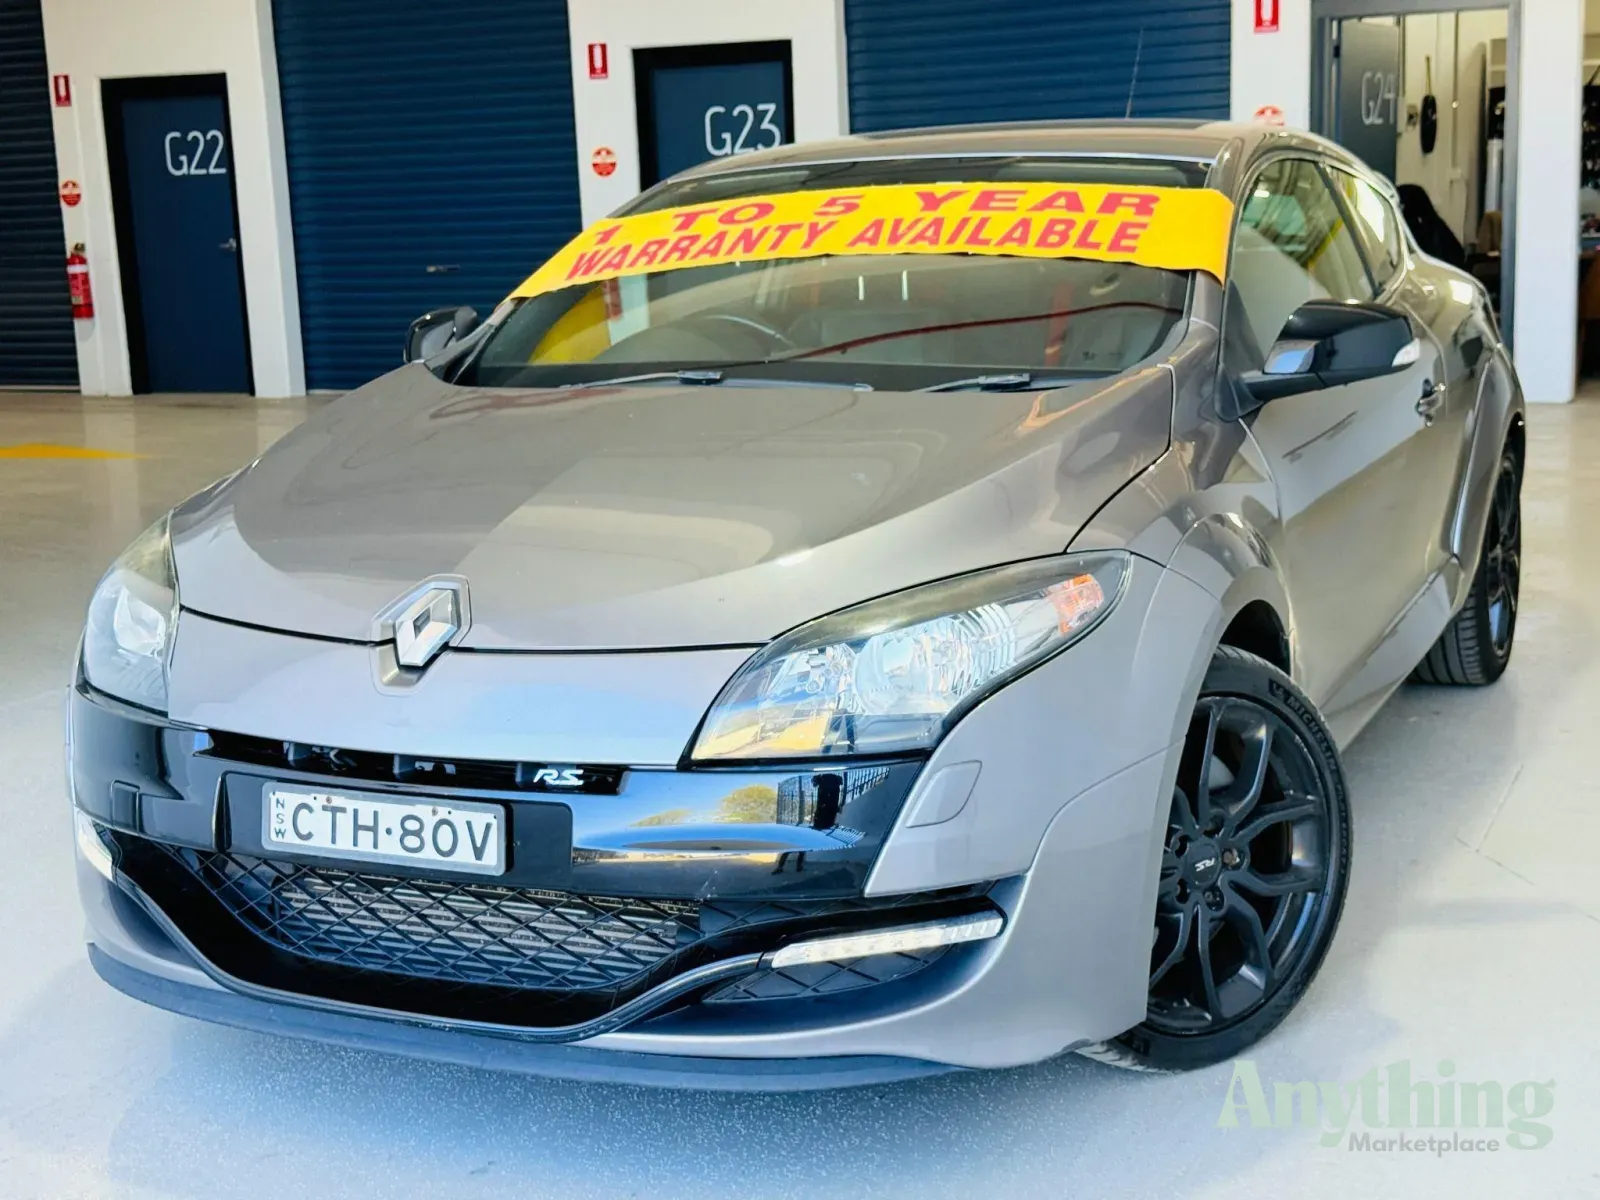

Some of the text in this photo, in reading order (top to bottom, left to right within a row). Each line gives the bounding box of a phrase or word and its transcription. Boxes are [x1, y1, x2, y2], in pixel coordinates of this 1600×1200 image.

[1361, 71, 1396, 125] G24
[165, 130, 227, 175] G22
[704, 103, 781, 155] G23
[596, 189, 1161, 245] 1 TO 5 YEAR
[565, 217, 1149, 281] WARRANTY AVAILABLE
[533, 768, 585, 786] RS
